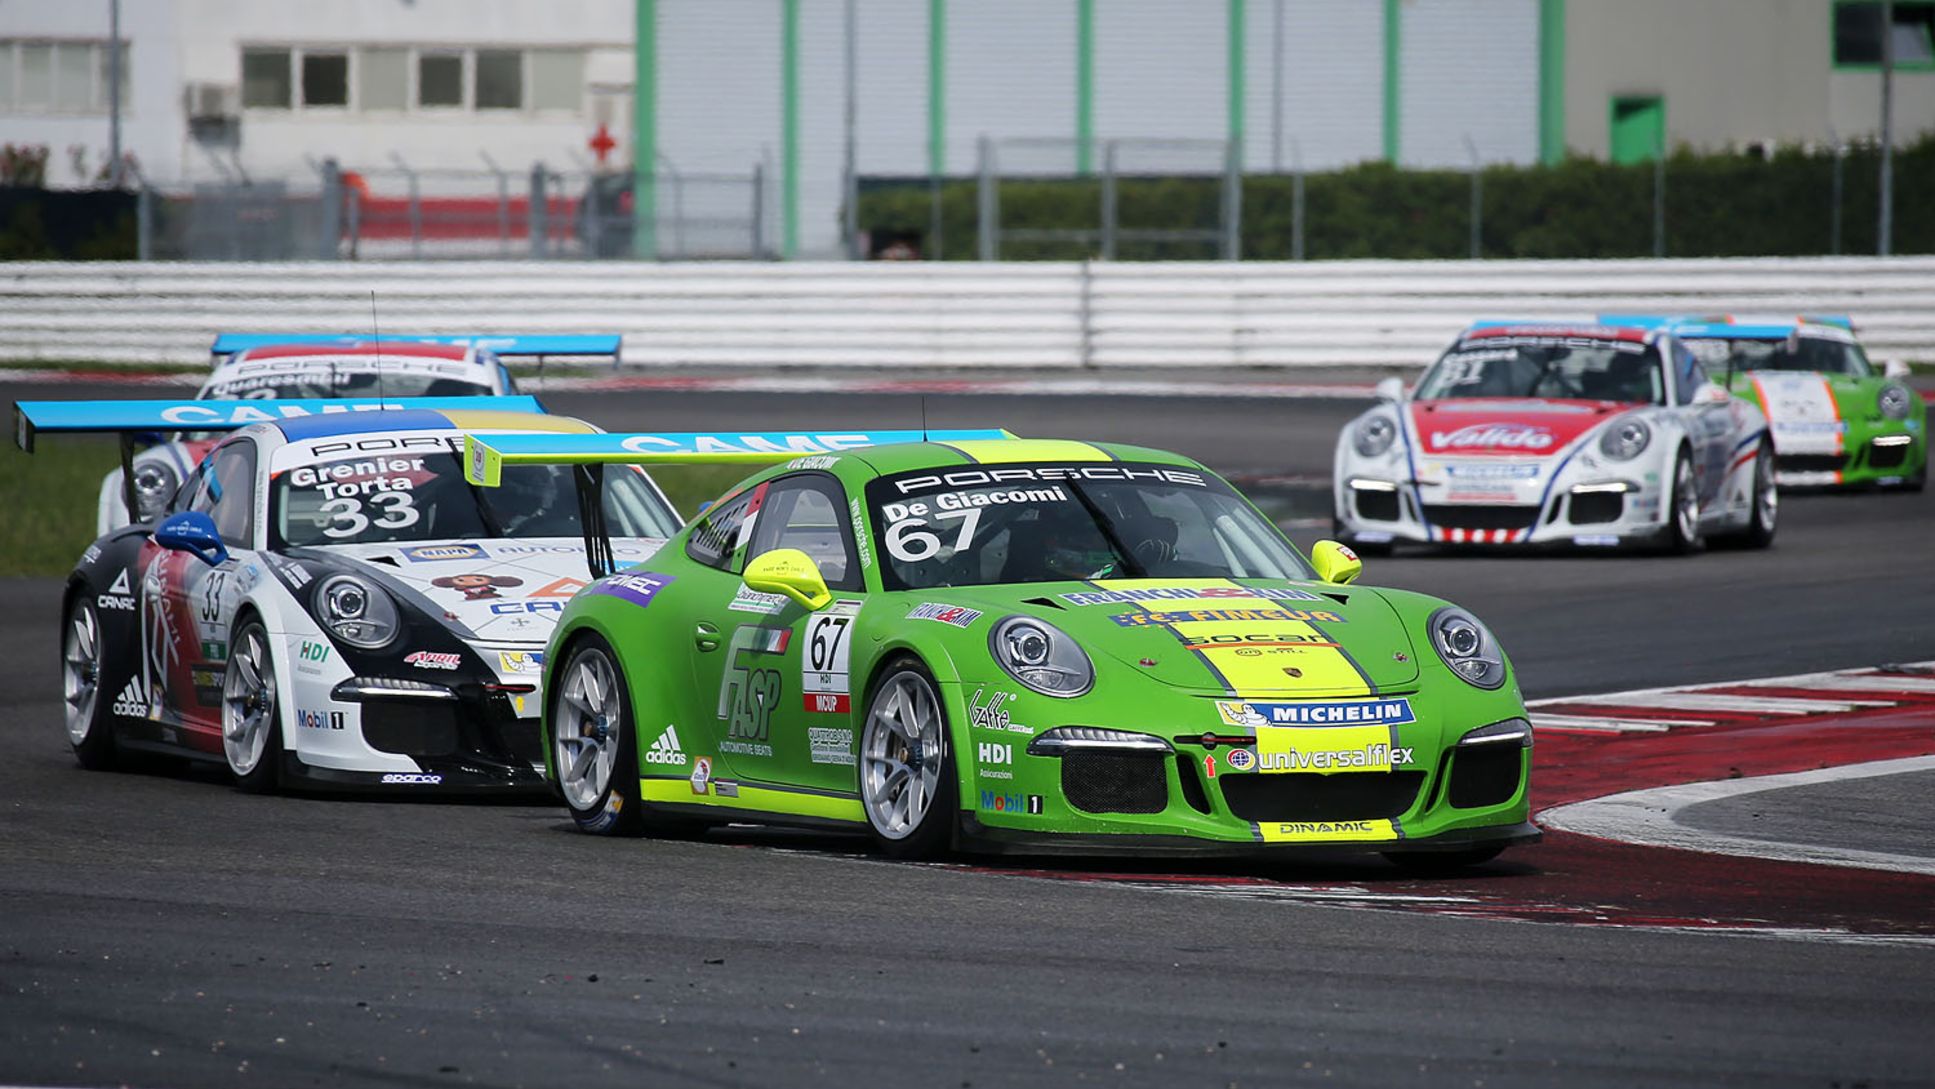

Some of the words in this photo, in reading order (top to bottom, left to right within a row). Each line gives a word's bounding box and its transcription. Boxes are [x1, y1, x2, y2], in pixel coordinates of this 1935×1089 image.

[291, 457, 425, 487] Grenier
[895, 467, 1206, 494] PORSCHE
[316, 476, 413, 500] Torta
[319, 491, 420, 539] 33
[882, 502, 929, 523] De
[935, 486, 1068, 511] Giacomi
[885, 508, 982, 563] 67
[421, 547, 468, 557] NAPA
[202, 572, 225, 623] 33
[811, 617, 850, 671] 67
[1184, 634, 1323, 644] socar
[300, 640, 330, 663] HDI
[113, 702, 147, 717] adidas
[298, 709, 329, 729] Mobil
[332, 711, 344, 730] 1
[1273, 704, 1402, 721] MICHELIN
[645, 749, 687, 766] adidas
[979, 742, 1013, 765] HDI
[1258, 744, 1414, 769] universalflex
[381, 773, 442, 785] sparco
[981, 791, 1024, 813] Mobil
[1028, 795, 1042, 814] 1
[1279, 822, 1374, 834] DINAMIC
